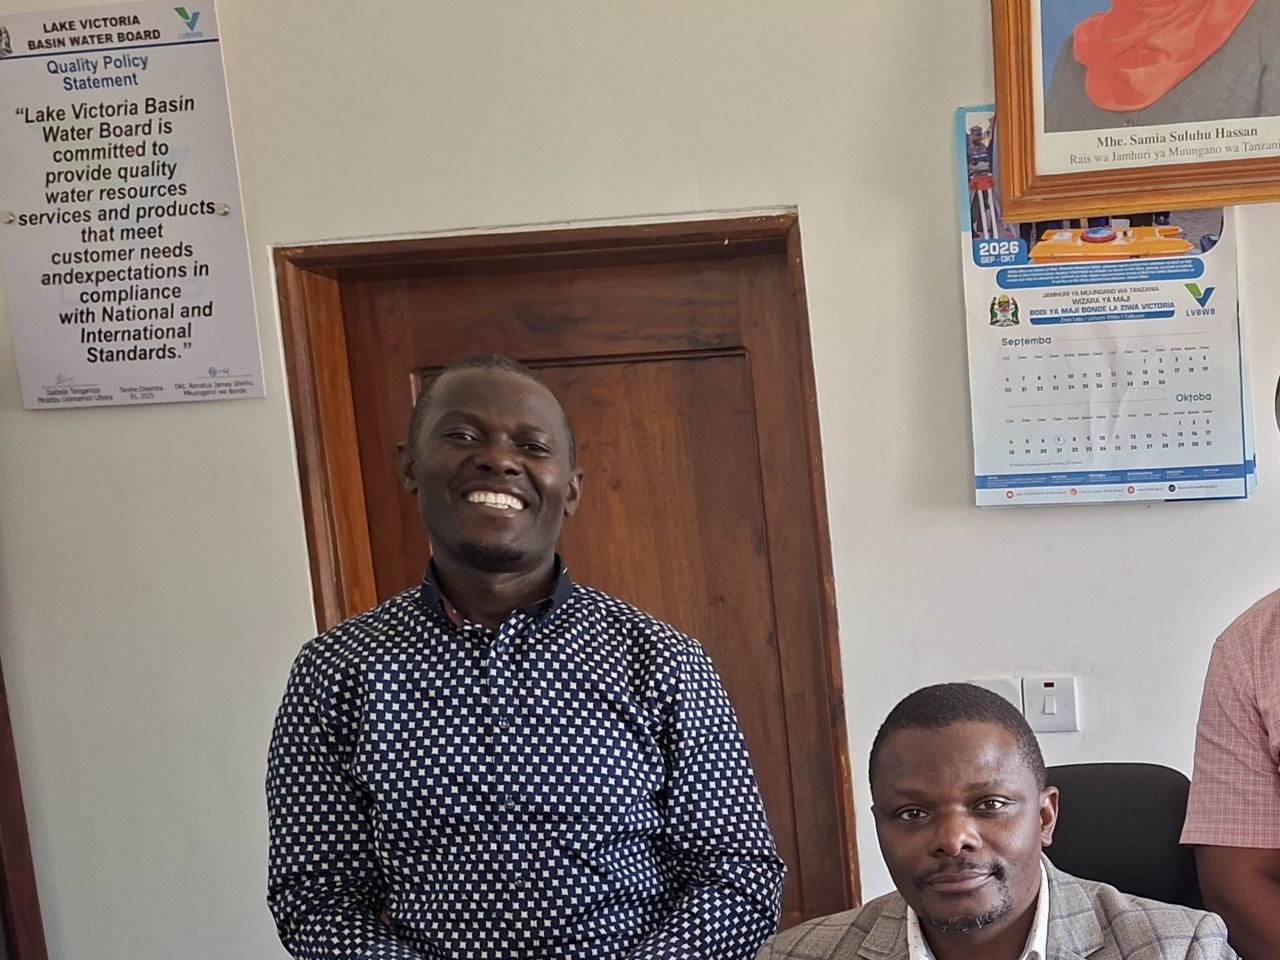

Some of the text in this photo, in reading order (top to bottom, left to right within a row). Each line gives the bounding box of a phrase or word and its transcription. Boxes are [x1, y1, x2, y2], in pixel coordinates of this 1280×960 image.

[43, 15, 140, 34] LAKE VICTORIA
[28, 29, 161, 50] BASIN WATER BOARD
[47, 55, 148, 75] Quality Policy
[64, 73, 138, 91] Statement
[71, 100, 138, 120] Victoria
[145, 95, 195, 114] Basin
[43, 119, 172, 143] Water Board is
[1097, 127, 1258, 148] Mhe. Samia Suluhu Hassan
[53, 141, 168, 162] committed to
[1070, 153, 1091, 165] Rais
[1095, 154, 1109, 162] wa
[1112, 149, 1151, 162] Jamhuri
[1154, 150, 1165, 160] ya
[1169, 146, 1222, 158] Muungano
[1225, 144, 1239, 153] wa
[46, 161, 177, 187] provide quality
[46, 182, 187, 204] water resources
[18, 201, 215, 226] services and products
[81, 223, 163, 243] that meet
[52, 241, 193, 265] customer needs
[979, 242, 1019, 255] 2026
[981, 256, 995, 264] SEP
[1001, 255, 1015, 263] OKT
[41, 261, 209, 286] andexpectations in
[80, 284, 182, 305] compliance
[59, 301, 213, 324] with National and
[1082, 305, 1107, 313] BONDE
[1109, 304, 1119, 312] LA
[1120, 303, 1139, 311] ZIWA
[1142, 302, 1175, 310] VICTORIA
[1186, 309, 1216, 317] LVBWB
[81, 323, 192, 343] International
[1001, 336, 1052, 348] Septemba
[1176, 392, 1212, 403] Oktoba
